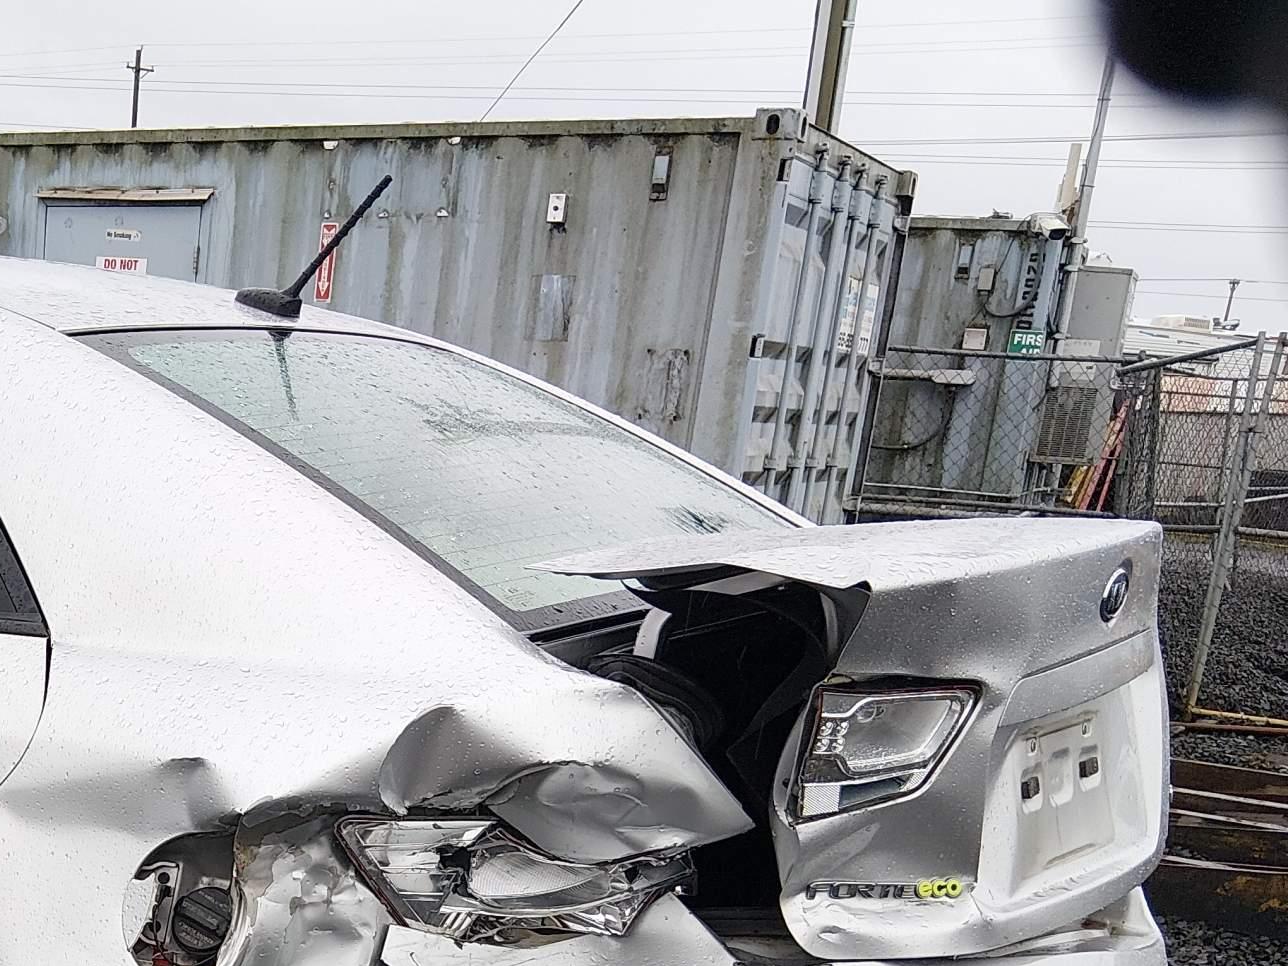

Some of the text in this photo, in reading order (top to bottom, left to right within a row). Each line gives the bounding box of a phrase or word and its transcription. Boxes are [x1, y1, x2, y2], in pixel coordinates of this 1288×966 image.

[104, 258, 139, 271] DO NOT
[1013, 333, 1044, 346] FIRS
[916, 877, 963, 900] eco
